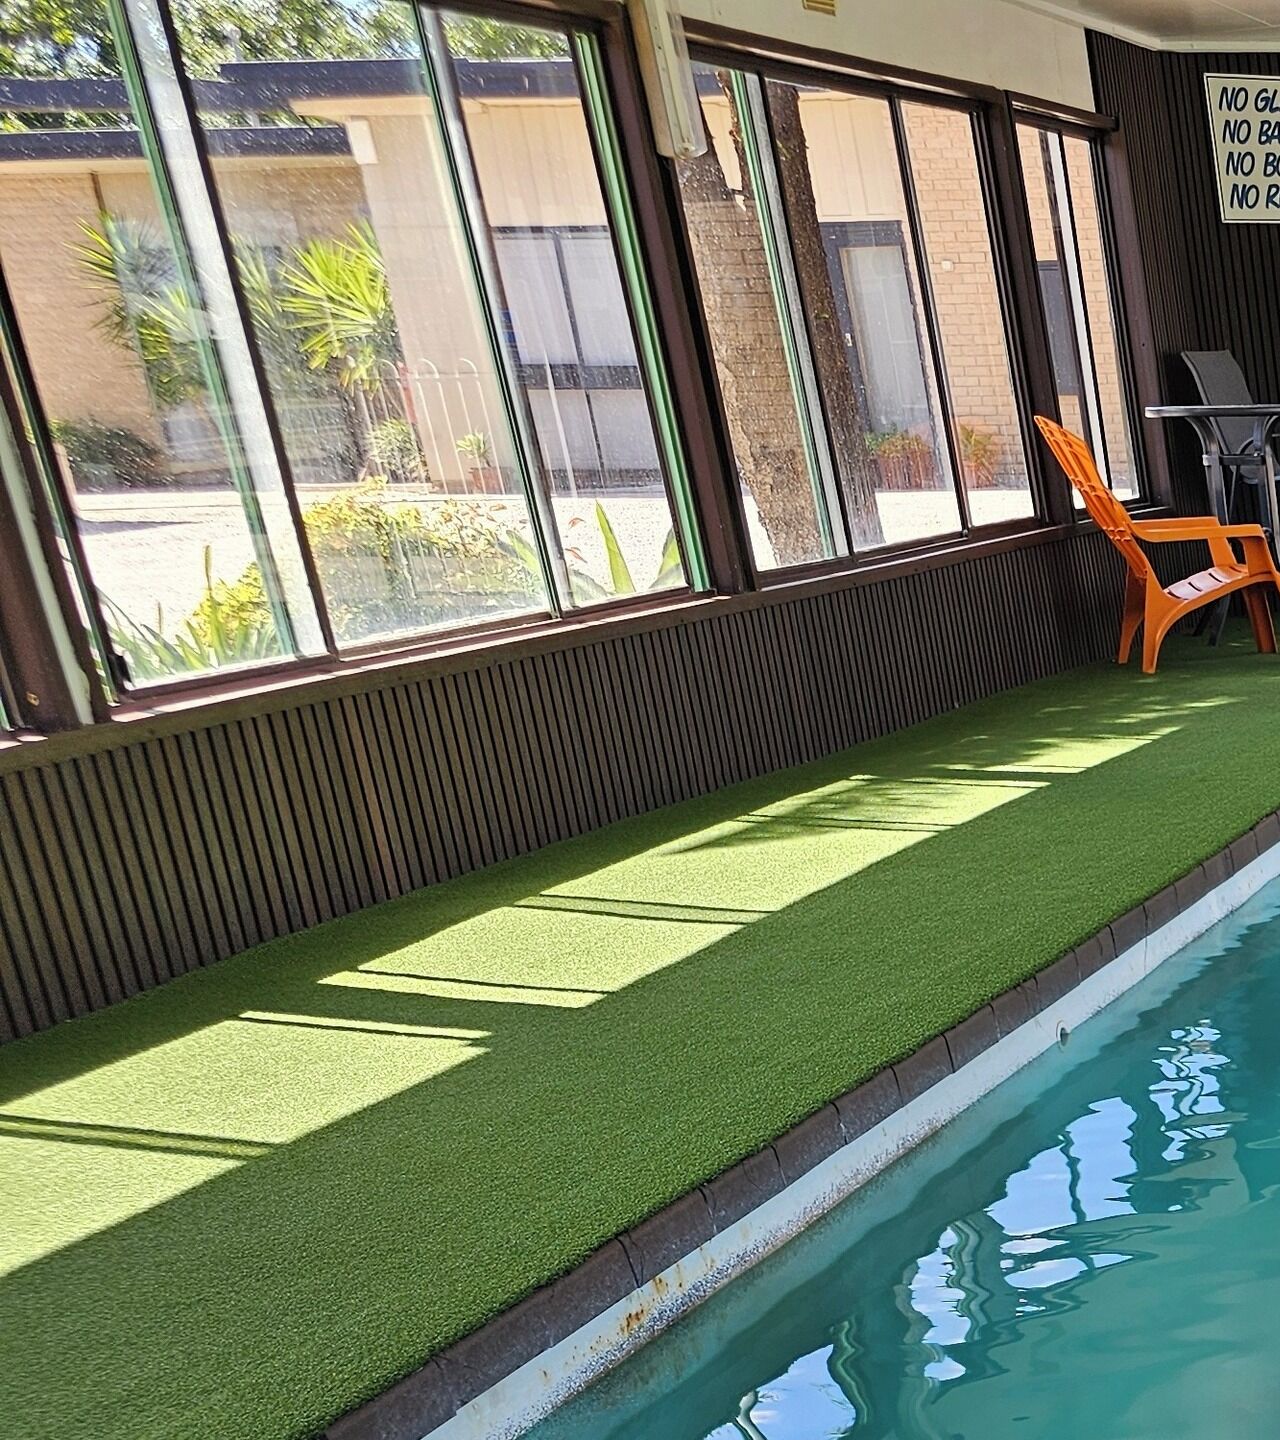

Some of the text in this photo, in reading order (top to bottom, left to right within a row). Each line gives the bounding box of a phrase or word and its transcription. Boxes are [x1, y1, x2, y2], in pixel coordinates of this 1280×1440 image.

[1218, 86, 1249, 112] NO
[1222, 119, 1252, 145] NO
[1225, 151, 1256, 177] NO
[1230, 183, 1260, 210] NO
